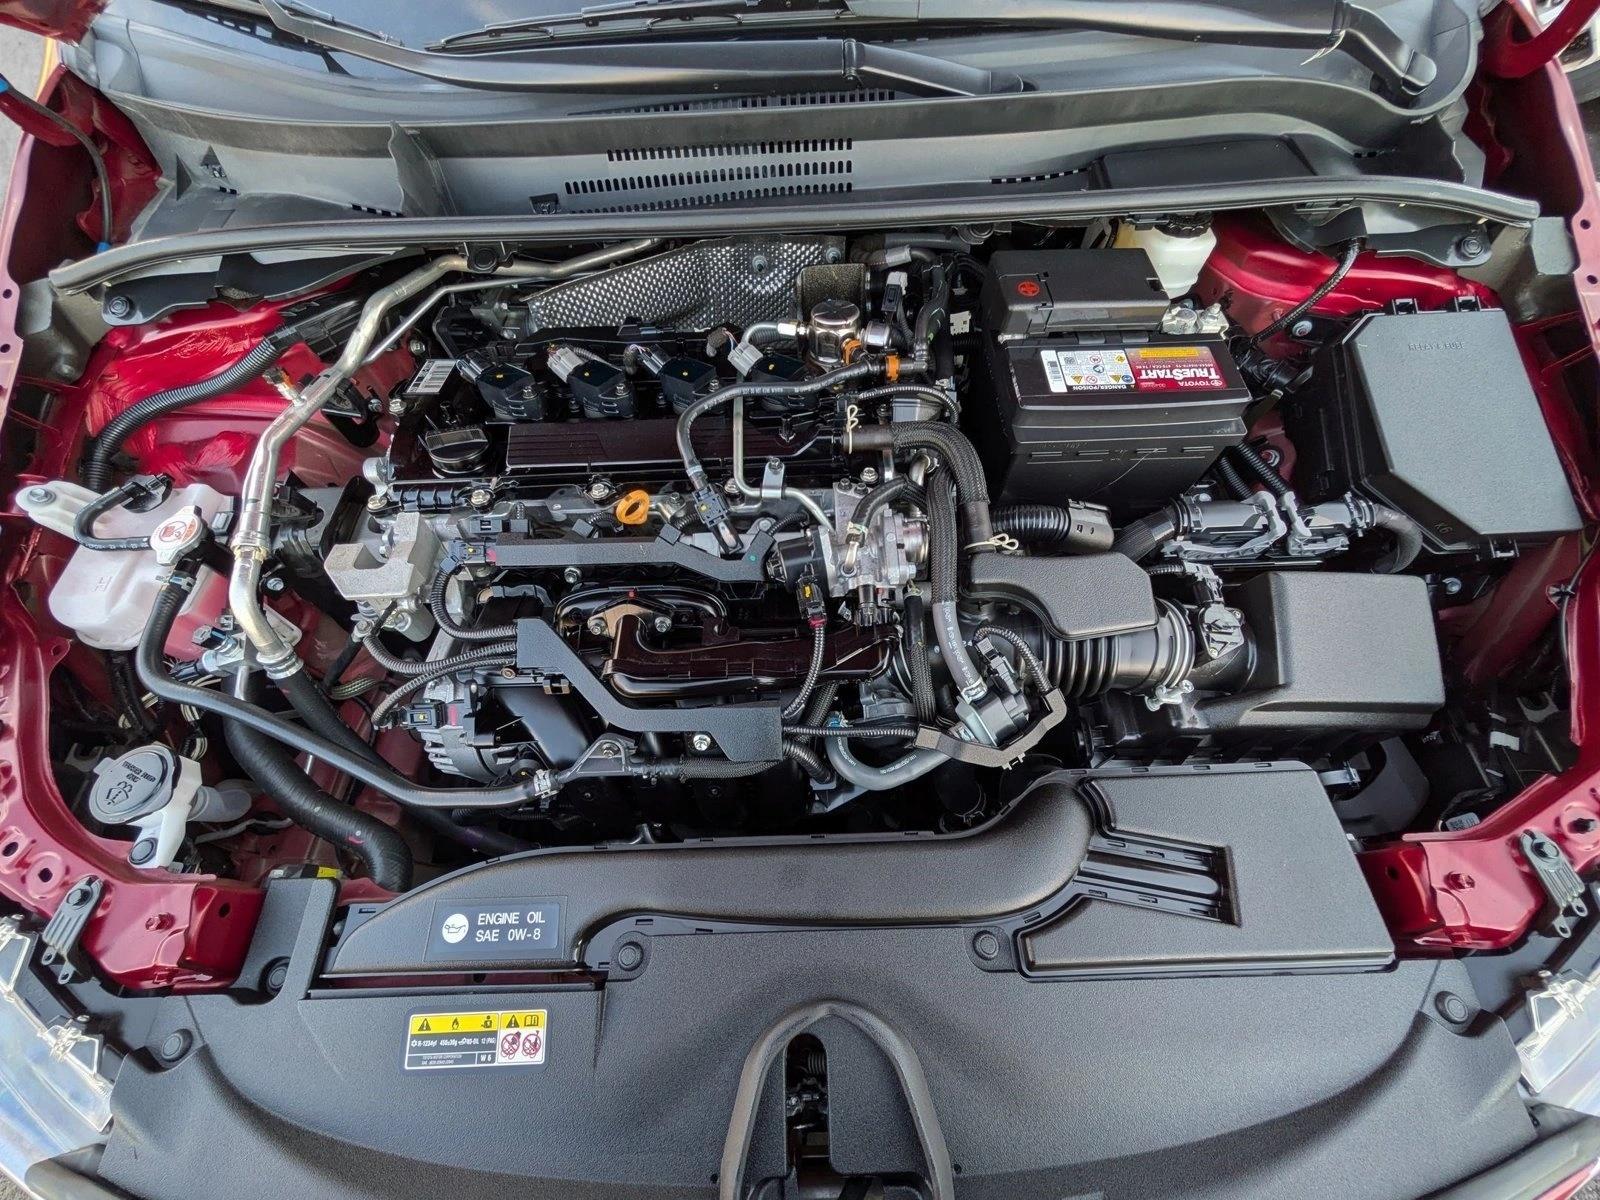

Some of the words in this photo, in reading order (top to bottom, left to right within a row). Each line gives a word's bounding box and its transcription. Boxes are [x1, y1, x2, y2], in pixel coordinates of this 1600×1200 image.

[477, 912, 520, 925] ENGINE
[526, 911, 546, 923] OIL
[475, 929, 500, 943] SAE
[507, 928, 541, 941] 0W-8
